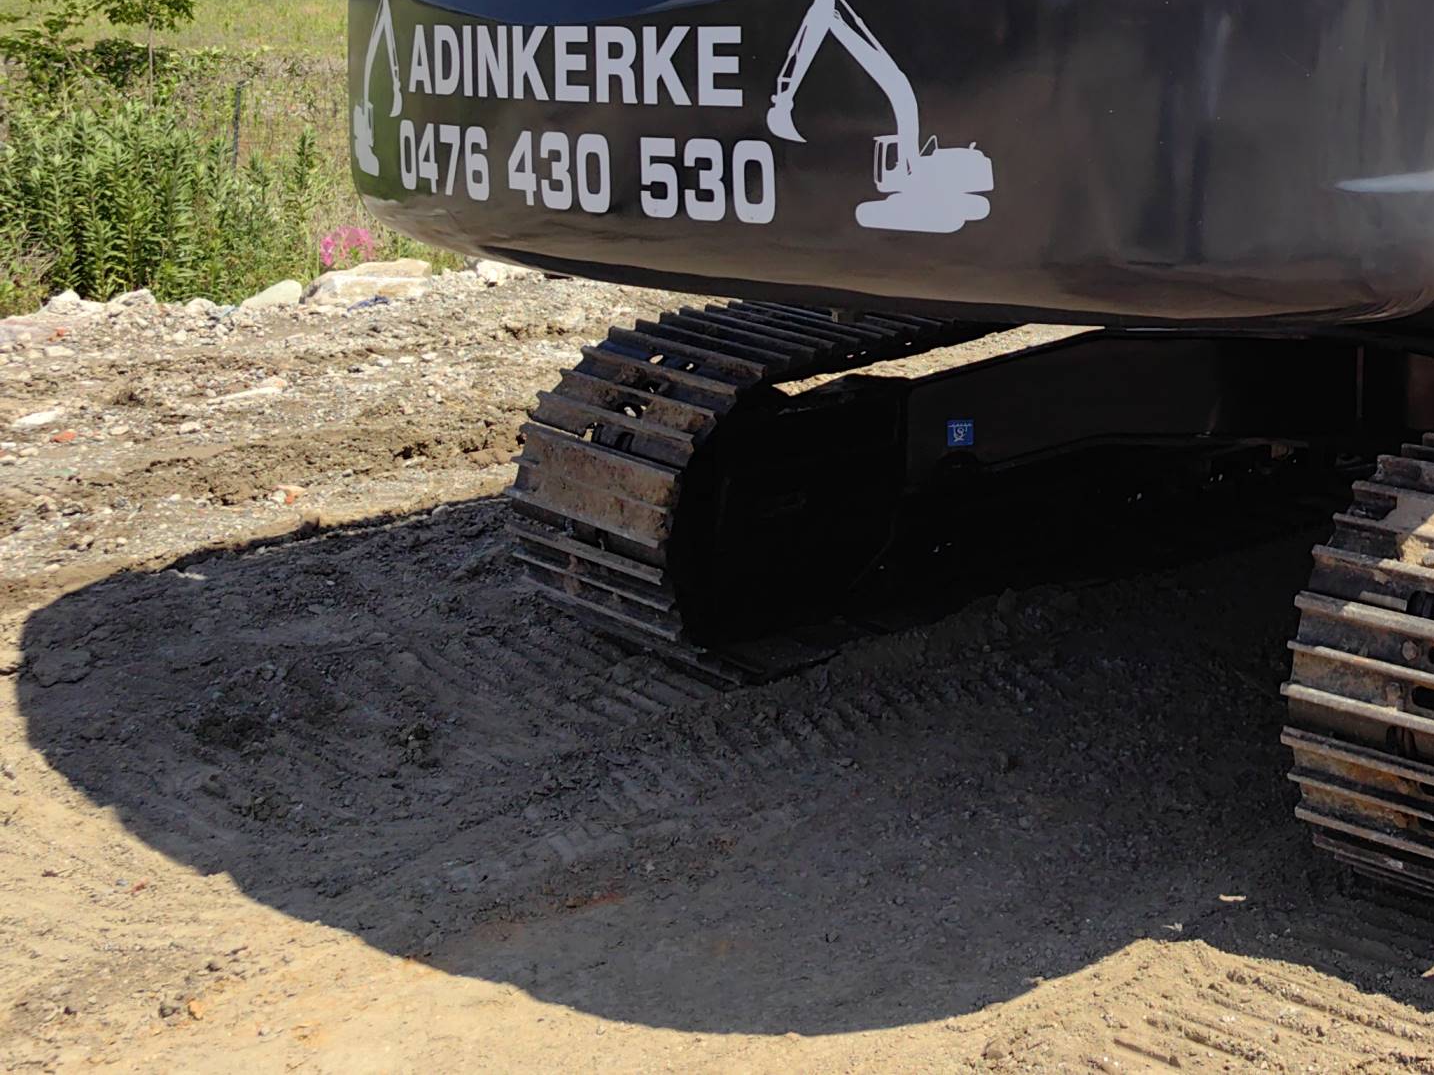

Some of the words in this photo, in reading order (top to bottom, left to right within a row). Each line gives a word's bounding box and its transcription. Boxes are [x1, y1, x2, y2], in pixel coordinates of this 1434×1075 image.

[408, 25, 743, 107] ADINKERKE
[400, 119, 488, 201] 0476
[507, 130, 610, 214] 430
[640, 137, 775, 223] 530
